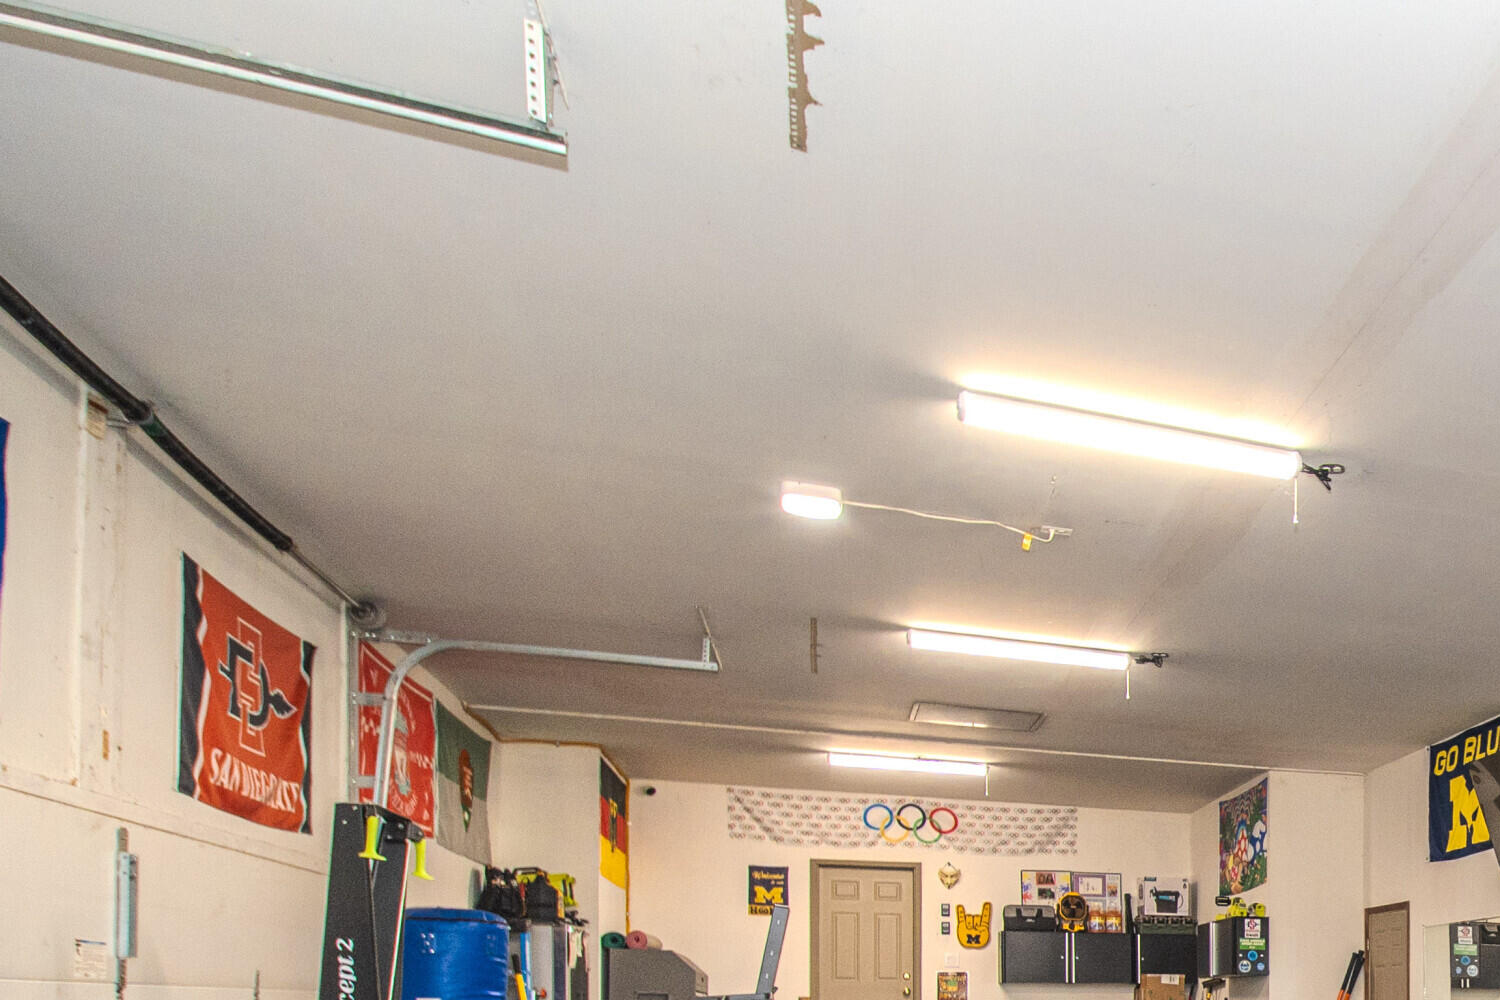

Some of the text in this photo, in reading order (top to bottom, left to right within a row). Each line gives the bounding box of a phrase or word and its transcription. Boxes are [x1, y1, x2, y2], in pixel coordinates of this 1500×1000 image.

[1434, 745, 1459, 776] GO
[754, 885, 784, 904] M
[335, 937, 354, 953] 2
[966, 934, 981, 944] M
